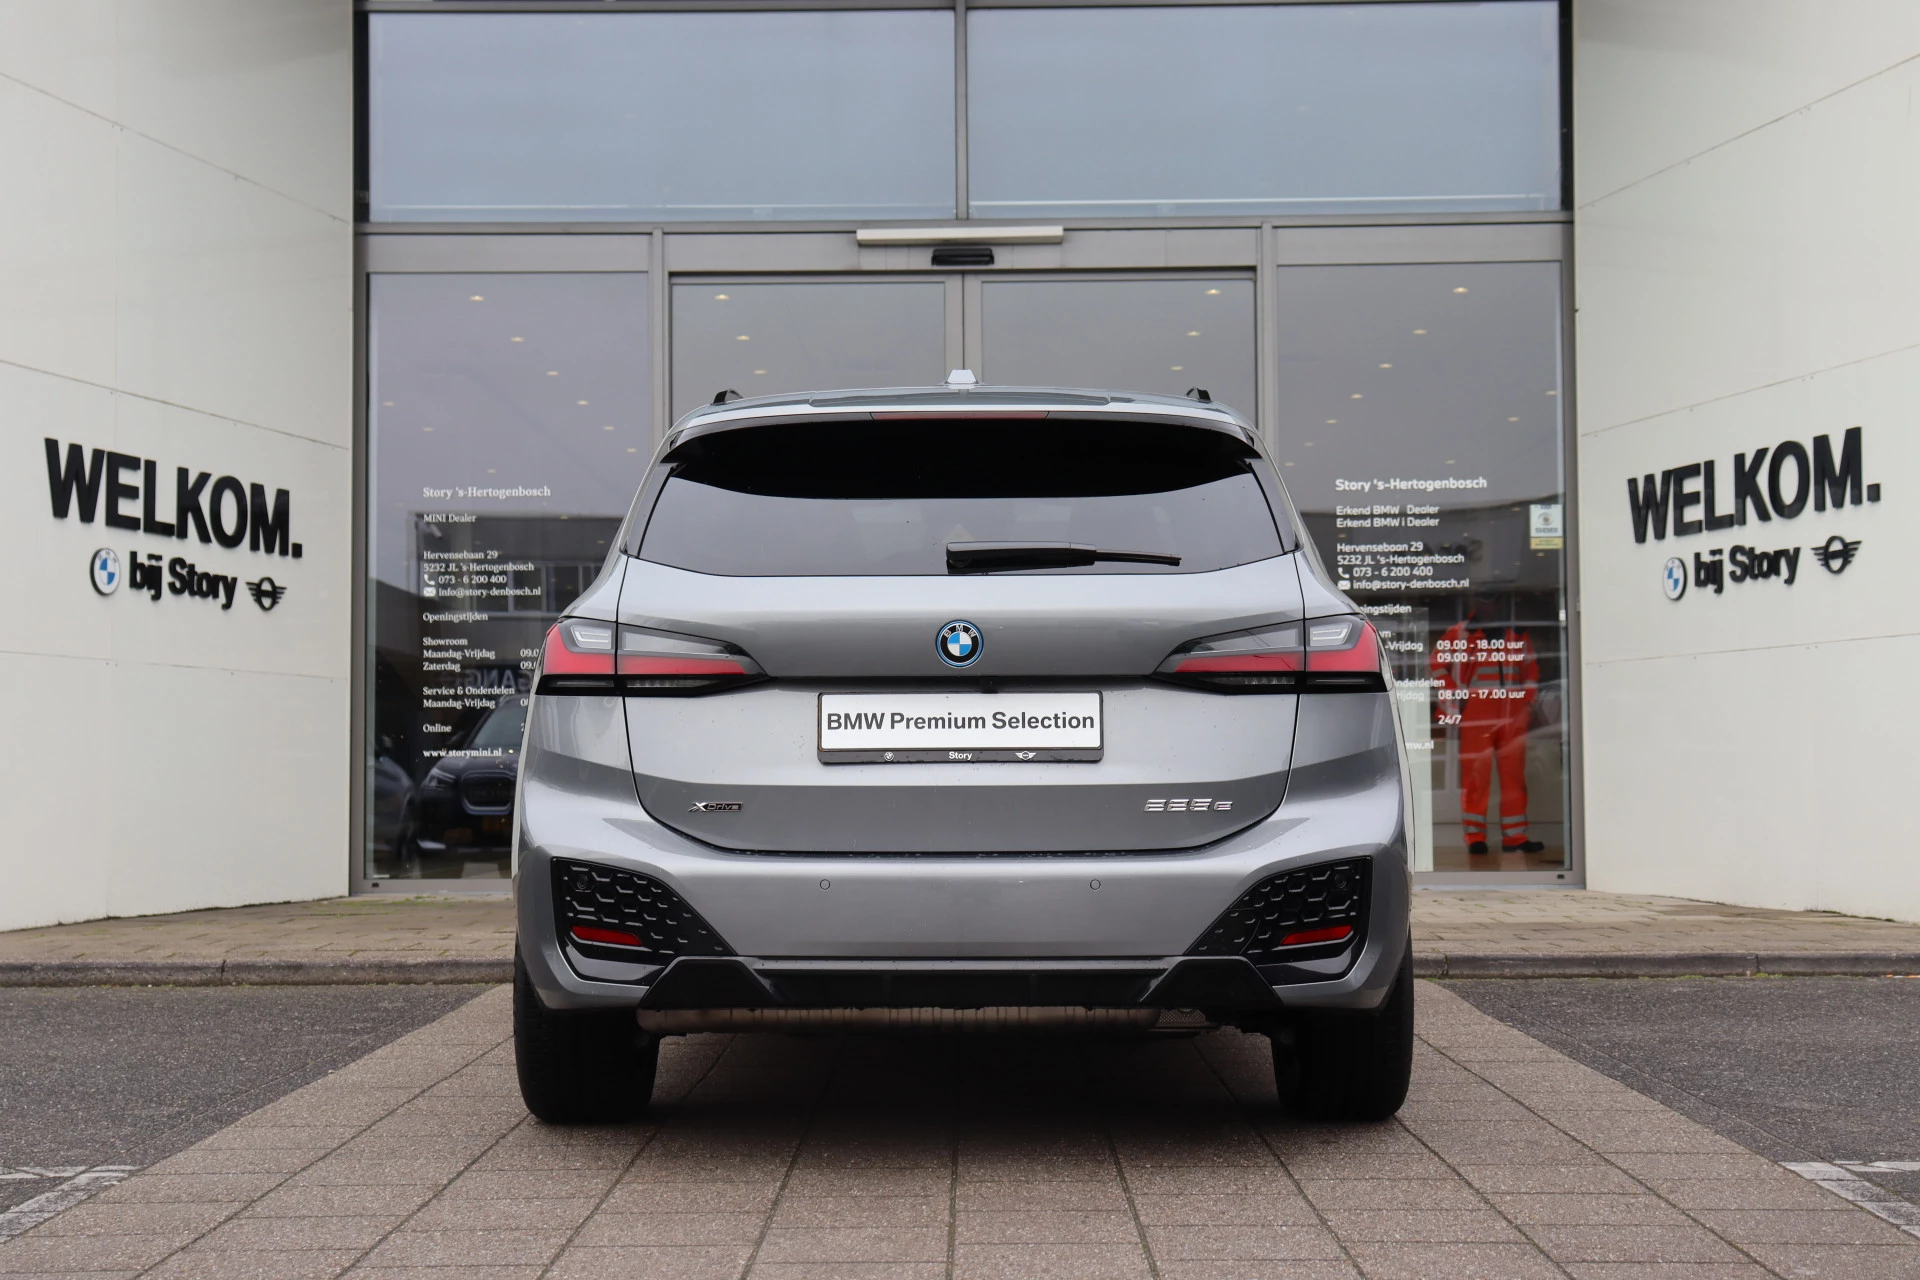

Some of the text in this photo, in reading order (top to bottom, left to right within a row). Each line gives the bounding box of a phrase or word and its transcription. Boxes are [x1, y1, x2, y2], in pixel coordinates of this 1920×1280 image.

[1335, 477, 1487, 492] Story 's-Hertogenbosch
[1627, 426, 1881, 544] WELKOM.
[44, 437, 302, 558] WELKOM.
[423, 486, 551, 499] Story 's-Hertogenbosch
[1336, 505, 1439, 516] Erkend BMW Dealer
[423, 514, 477, 523] MINI Dealer
[1336, 517, 1440, 528] Erkend BMW i Dealer
[1337, 542, 1423, 552] Hervensebaan 29
[423, 550, 498, 560] Hervensebaan 29
[1337, 554, 1464, 566] 5232 JL 's-Hertogenbosch
[423, 562, 534, 573] 5232 JL 's-Hertogenbosch
[1353, 568, 1371, 577] 073
[1381, 567, 1388, 577] 6
[1390, 567, 1410, 577] 200
[1412, 566, 1433, 576] 400
[1694, 545, 1801, 594] bij Story
[129, 551, 238, 610] bij Story
[438, 575, 455, 584] 073
[463, 575, 469, 584] 6
[471, 575, 488, 584] 200
[490, 575, 507, 583] 400
[1353, 579, 1469, 591] info@story-denbosch.nl
[438, 587, 541, 598] info@story-denbosch.nl
[423, 612, 488, 623] Openingstijden
[423, 637, 468, 646] Showroom
[1436, 640, 1467, 650] 09.00
[1476, 639, 1505, 649] 18.00
[1507, 640, 1524, 649] uur
[423, 648, 539, 660] Maandag-Vrijdag 09.0
[1437, 652, 1468, 662] 09.00
[1507, 653, 1525, 661] uur
[423, 662, 460, 672] Zaterdag
[1396, 678, 1445, 688] nderdelen
[423, 685, 515, 695] Service & Onderdelen
[1438, 690, 1469, 700] 08.00
[1509, 690, 1526, 699] uur
[423, 699, 496, 709] Maandag-Vrijdag
[827, 711, 1095, 730] BMW Premium Selection
[1438, 715, 1462, 725] 24/7
[423, 723, 452, 732] Online
[423, 748, 502, 758] www.storymini.nl
[948, 752, 973, 761] Story
